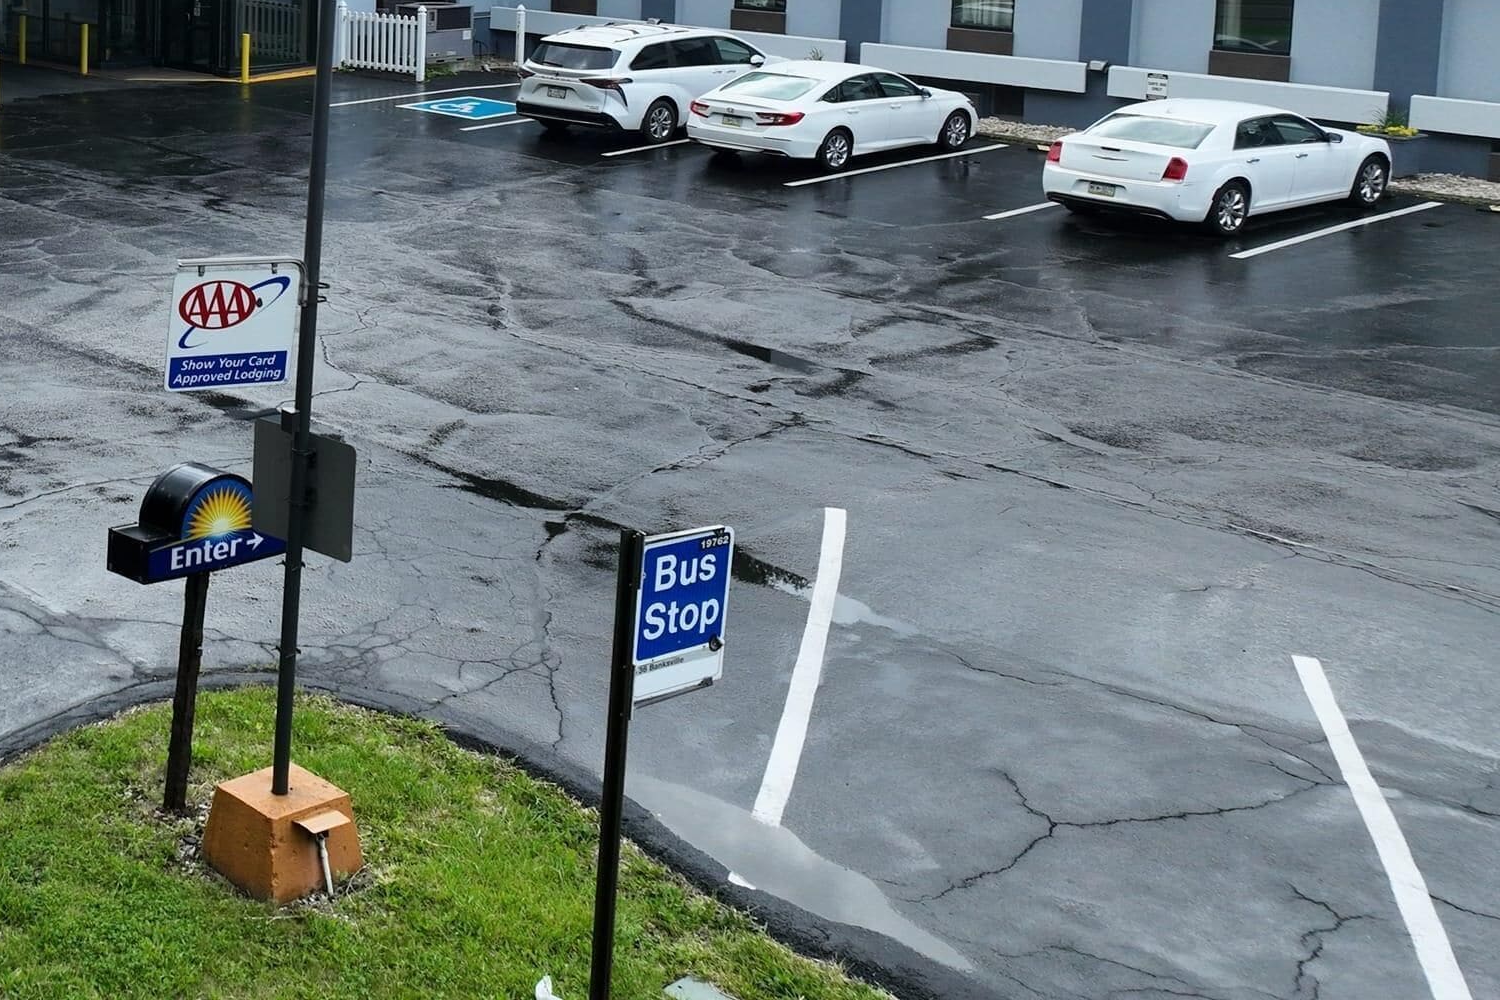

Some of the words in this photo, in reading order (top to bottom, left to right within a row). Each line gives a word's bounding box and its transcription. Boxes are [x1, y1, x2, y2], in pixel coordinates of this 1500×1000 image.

[188, 282, 247, 328] AAA
[172, 369, 232, 386] Approved
[234, 367, 282, 381] Lodging
[181, 360, 215, 371] Show
[219, 357, 246, 368] Your
[249, 354, 276, 366] Card
[171, 538, 243, 571] Enter
[701, 536, 730, 549] 19762
[654, 553, 717, 593] Bus
[643, 598, 720, 641] Stop
